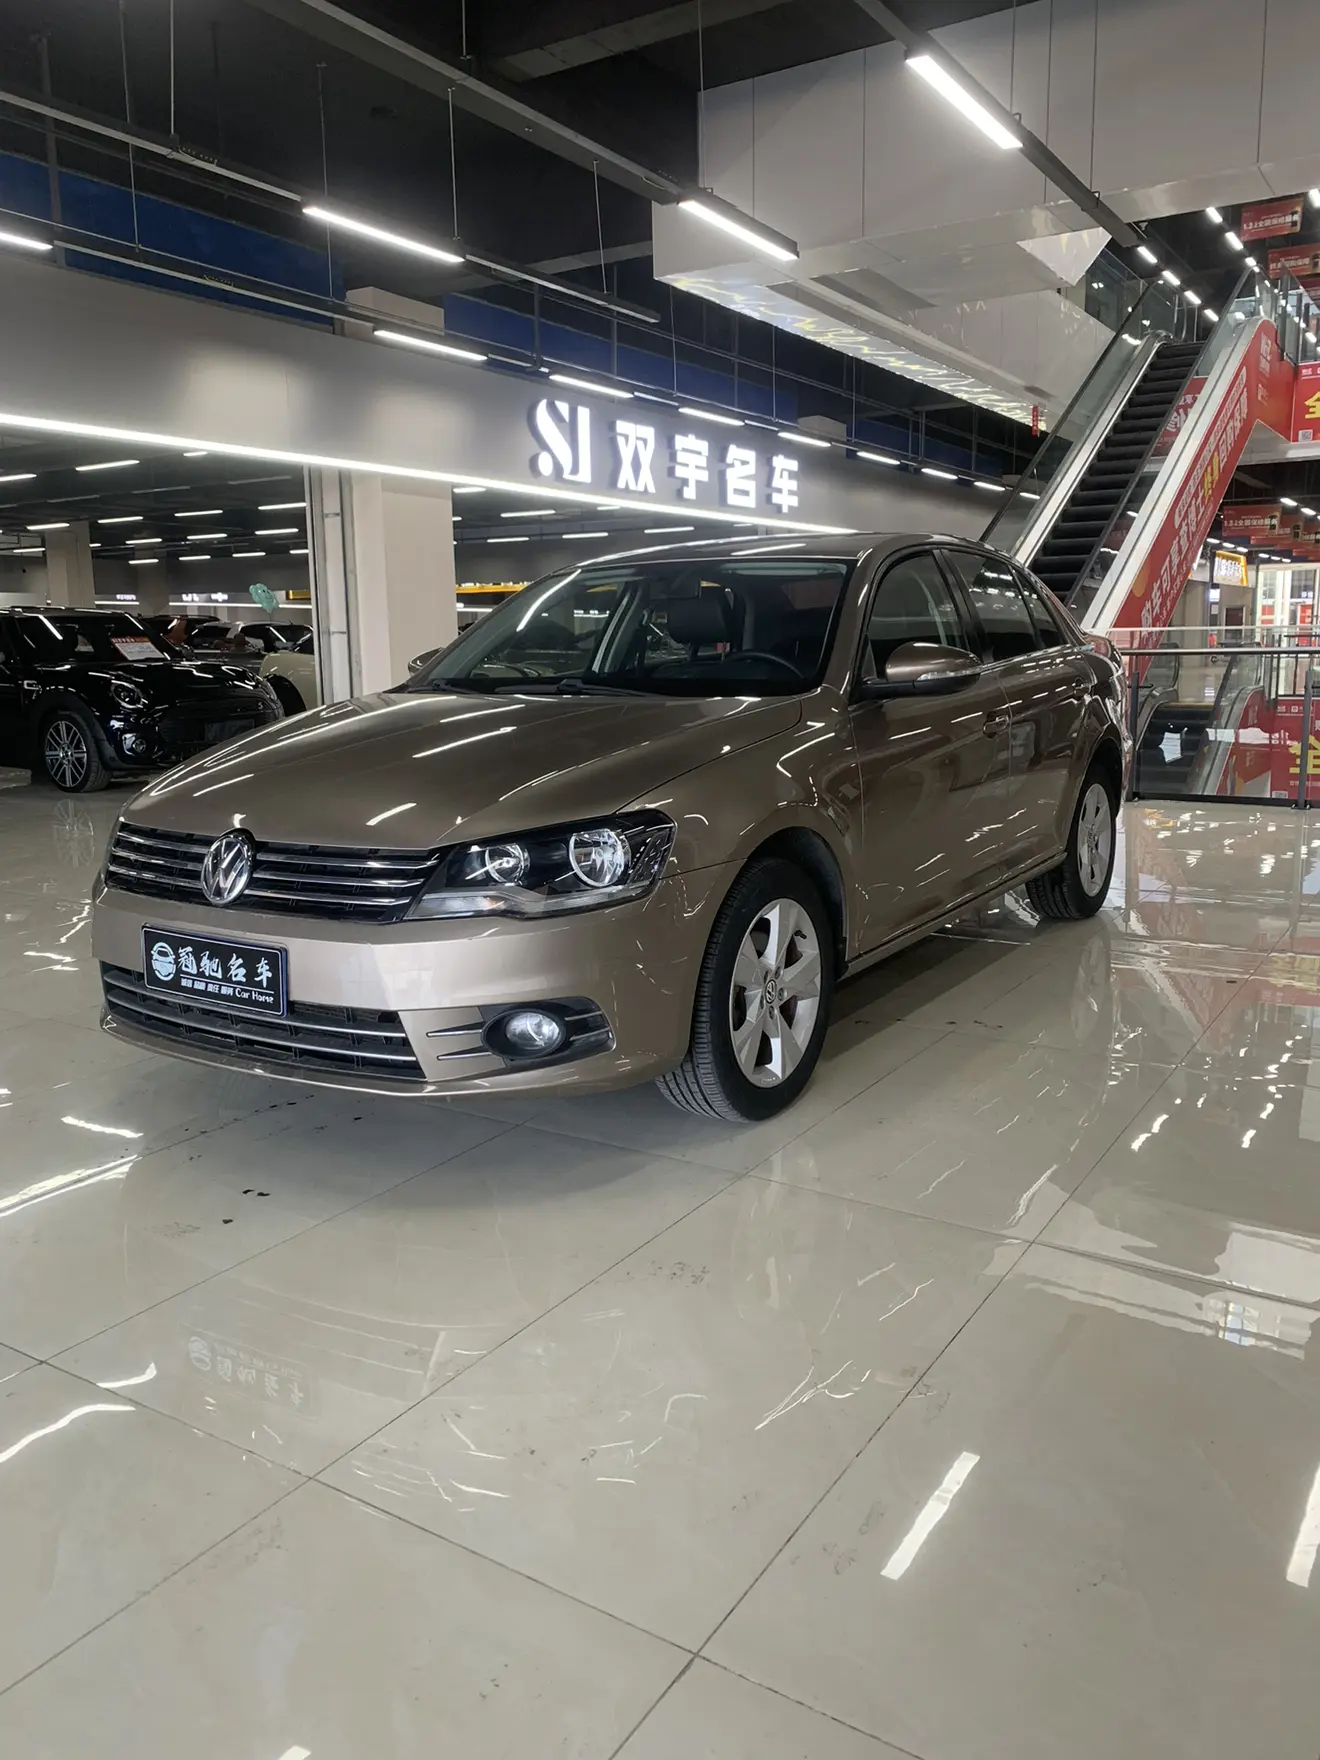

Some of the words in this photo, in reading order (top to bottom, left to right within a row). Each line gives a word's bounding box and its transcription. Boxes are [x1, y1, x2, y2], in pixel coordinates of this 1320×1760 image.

[615, 418, 799, 514] 双宇名车
[177, 945, 273, 989] 冠驰名车
[235, 987, 251, 999] Car
[251, 990, 274, 1004] Home
